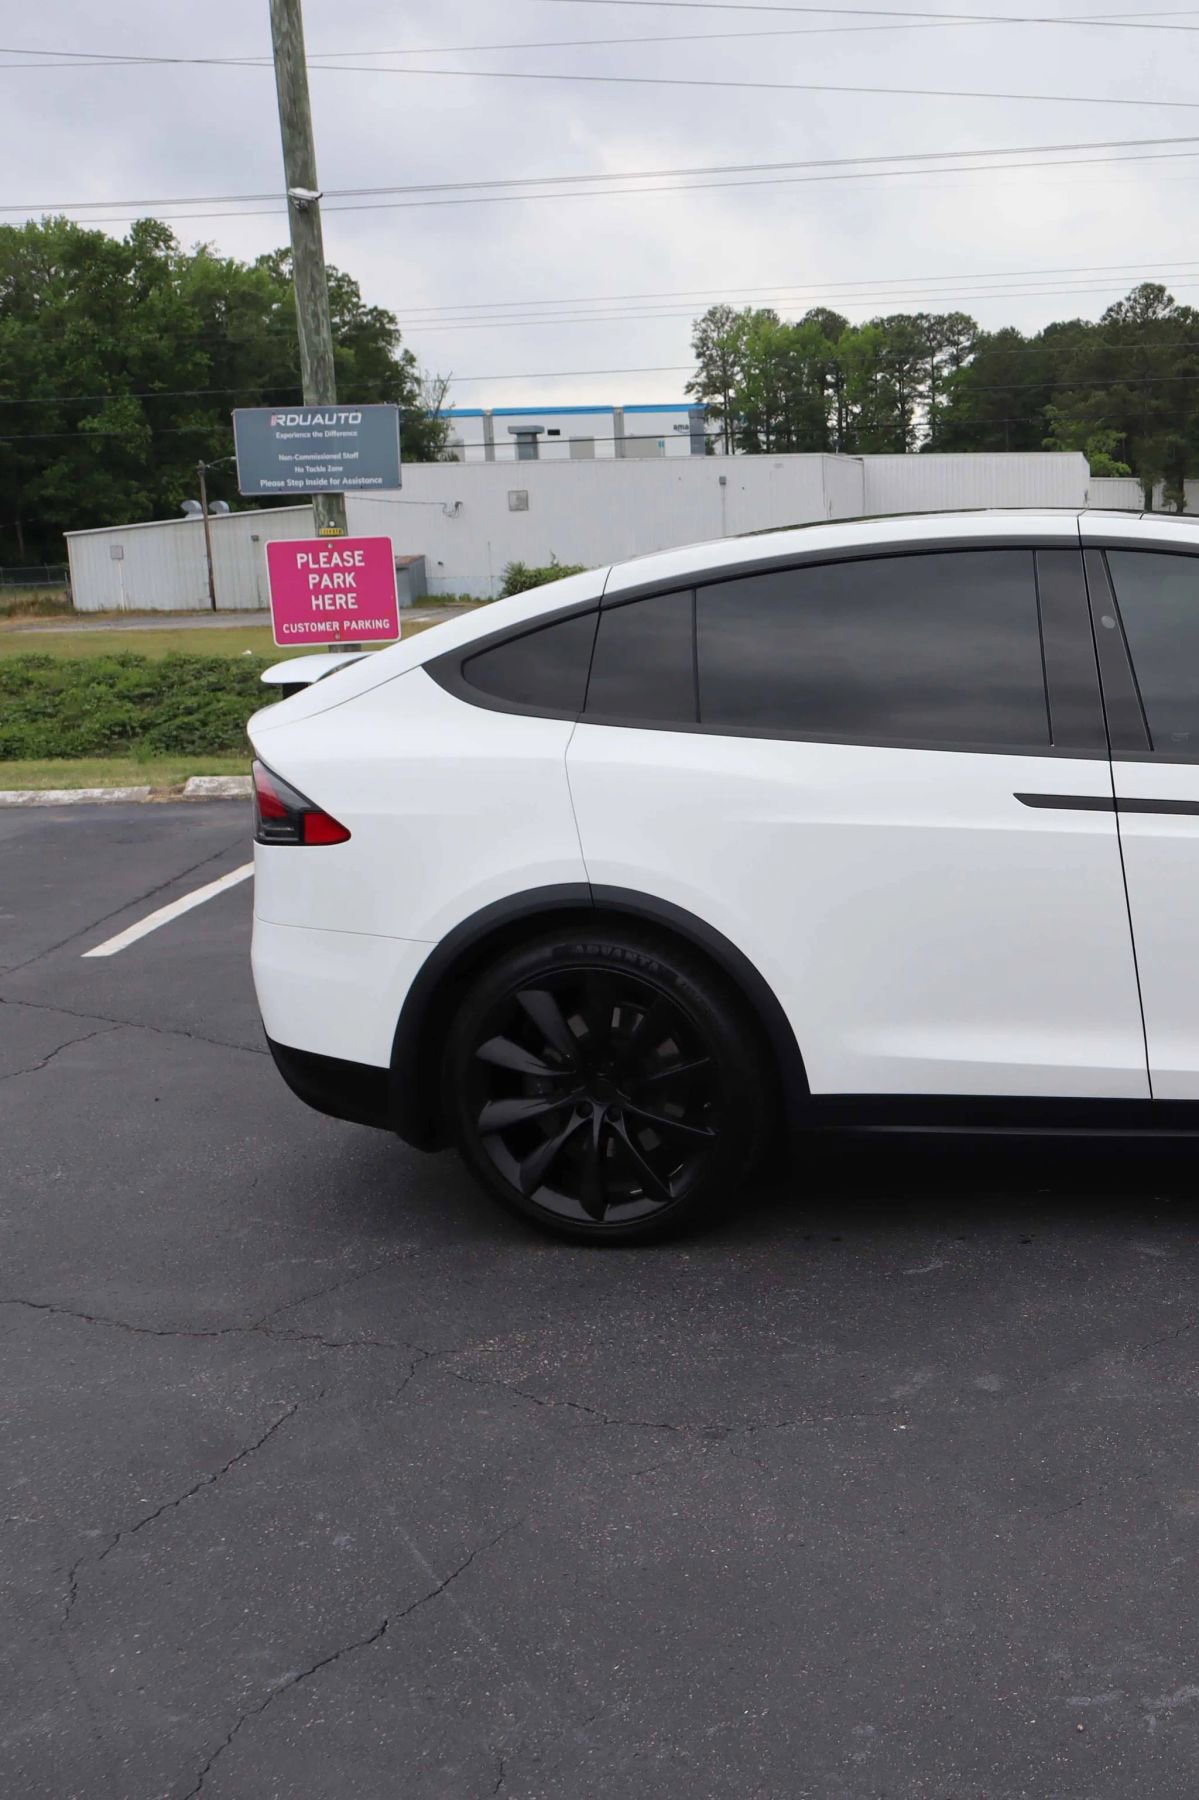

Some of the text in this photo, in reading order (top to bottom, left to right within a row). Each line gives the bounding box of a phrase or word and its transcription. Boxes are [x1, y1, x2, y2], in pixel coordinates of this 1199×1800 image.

[276, 431, 311, 439] Experience
[278, 453, 342, 461] Non-Commissioned
[328, 464, 343, 472] Zone
[260, 477, 383, 488] Please Step Inside for Assistance
[296, 551, 365, 569] PLEASE
[308, 572, 357, 590] PARK
[311, 593, 358, 611] HERE
[282, 618, 390, 634] CUSTOMER PARKING
